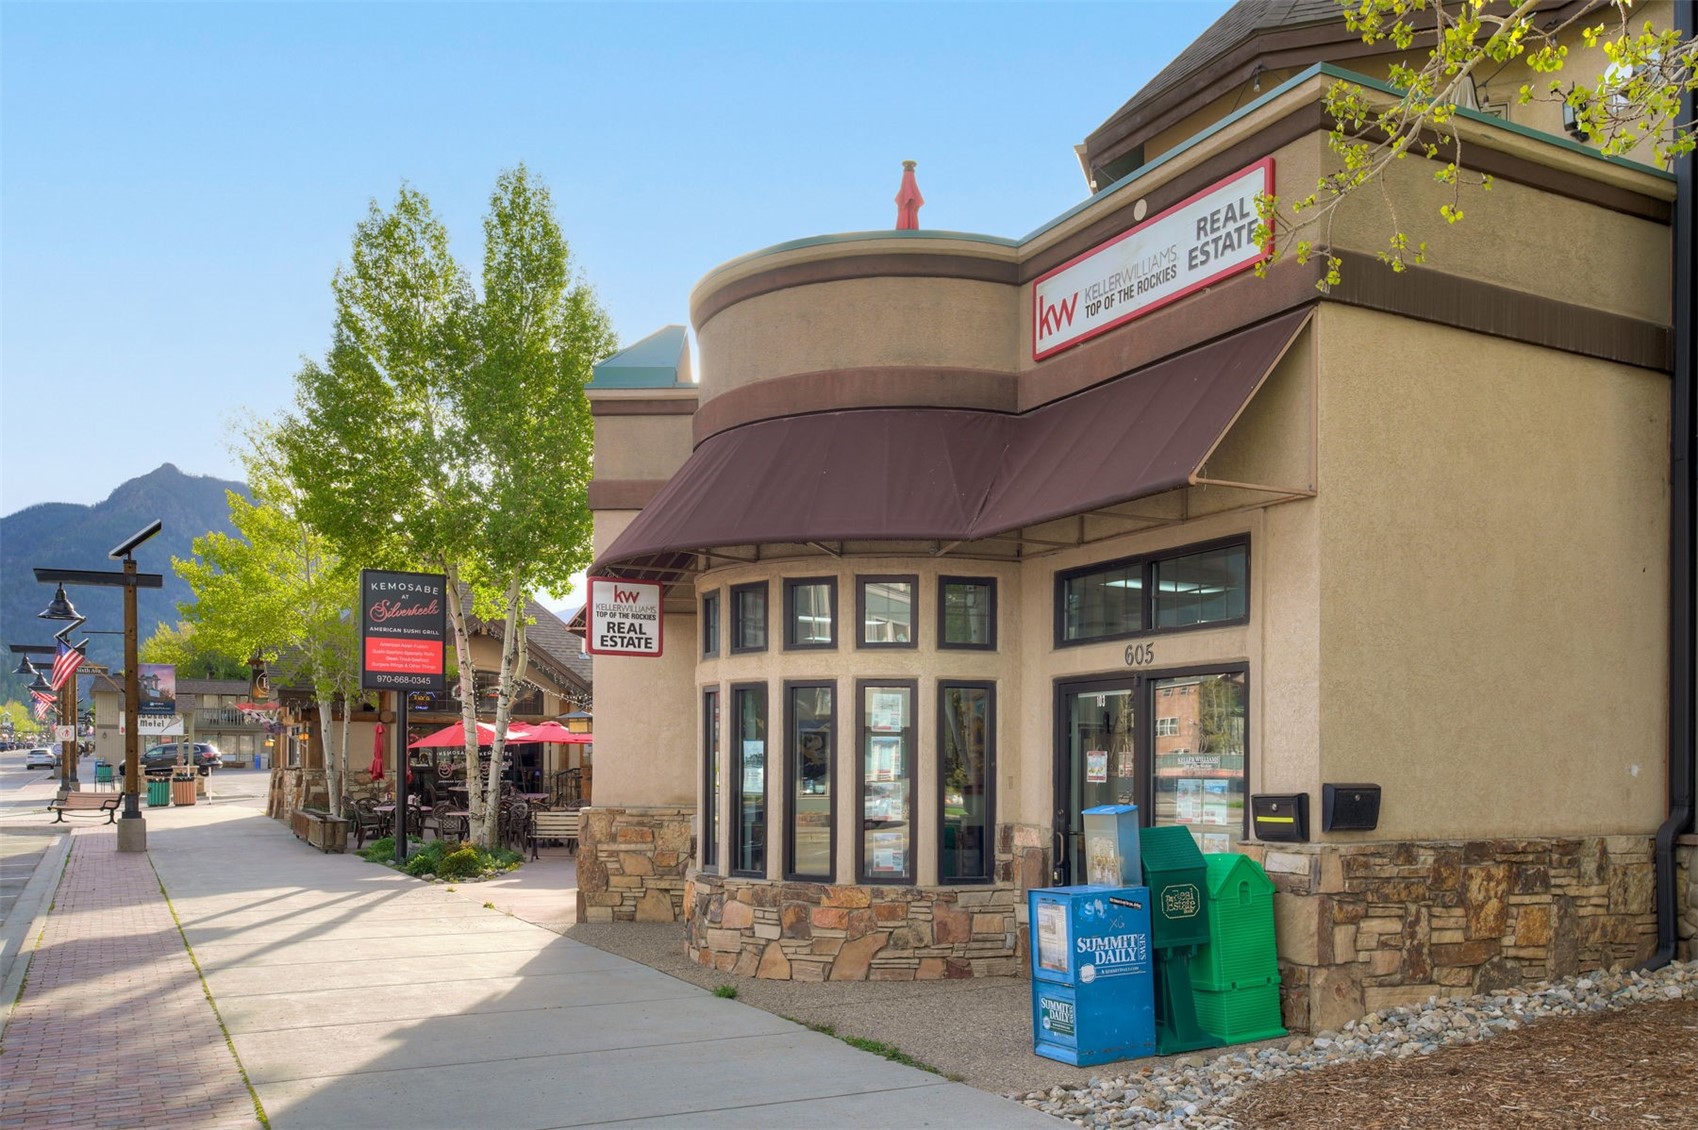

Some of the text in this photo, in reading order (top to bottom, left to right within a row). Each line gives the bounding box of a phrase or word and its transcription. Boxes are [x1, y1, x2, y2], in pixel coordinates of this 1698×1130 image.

[1196, 197, 1250, 241] REAL
[1188, 218, 1259, 271] ESTATE
[1085, 264, 1177, 318] TOP OF THE ROCKIES
[1039, 292, 1079, 340] kw
[371, 582, 439, 595] KEMOSABE
[614, 585, 640, 604] kw
[369, 599, 440, 622] Silverheels
[609, 611, 617, 619] OF
[618, 612, 630, 620] THE
[631, 613, 657, 621] ROCKIES
[606, 621, 647, 635] REAL
[600, 635, 653, 650] ESTATE
[1124, 642, 1155, 666] 605
[376, 675, 431, 685] 970-668-0345
[140, 719, 165, 727] Motel
[1076, 934, 1138, 953] SUMMIT
[1095, 947, 1137, 965] DAILY
[1040, 997, 1070, 1014] SUMMIT
[1050, 1009, 1070, 1024] DAILY
